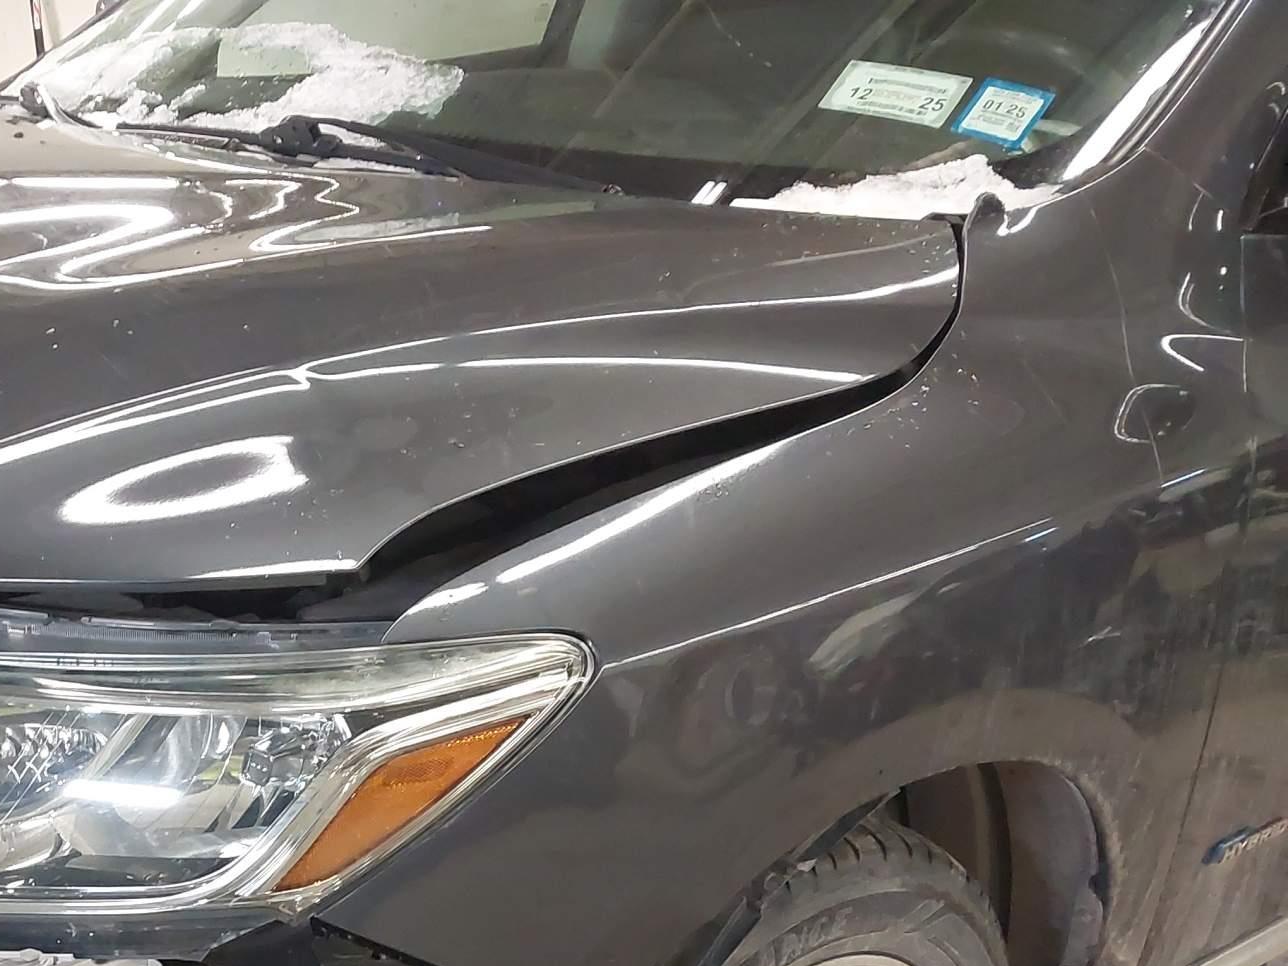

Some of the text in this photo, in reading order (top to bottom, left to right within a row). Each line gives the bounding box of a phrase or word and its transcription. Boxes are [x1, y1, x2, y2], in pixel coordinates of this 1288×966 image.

[850, 87, 873, 101] 12
[918, 97, 948, 112] 25
[983, 99, 1028, 119] 01 25
